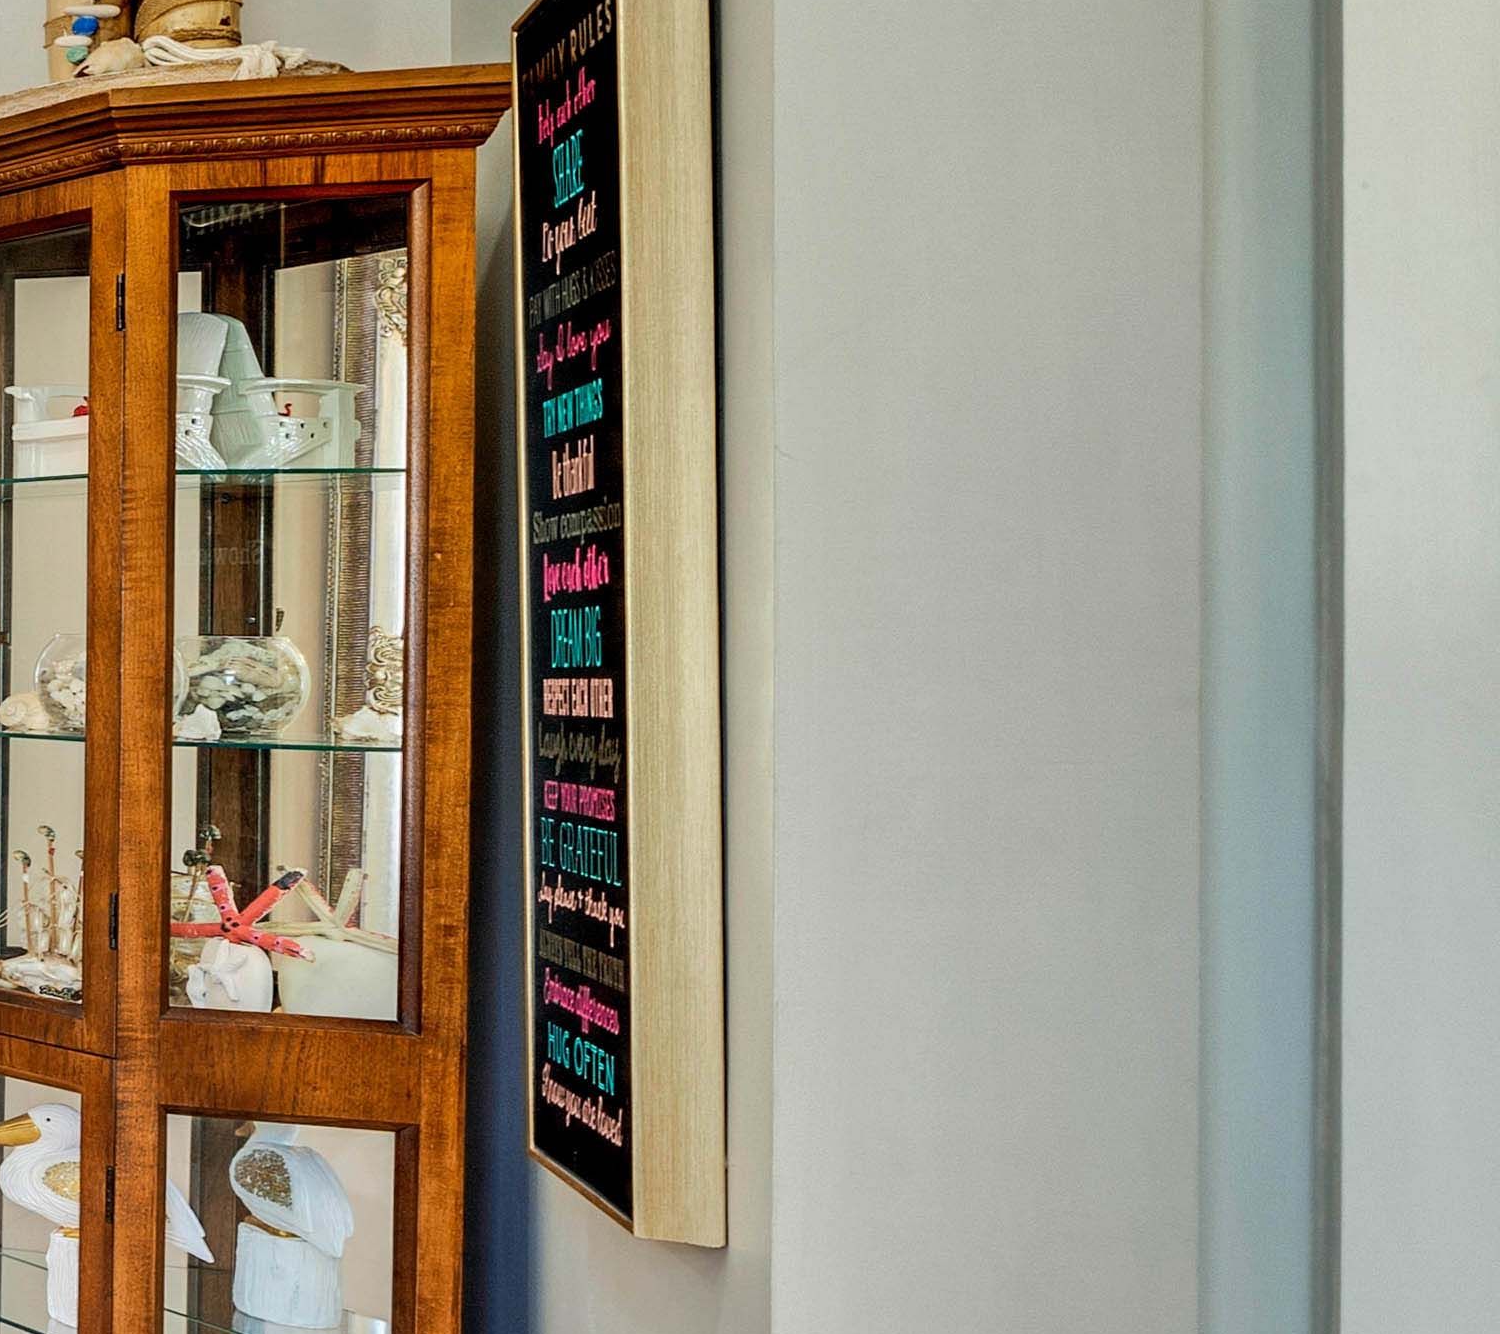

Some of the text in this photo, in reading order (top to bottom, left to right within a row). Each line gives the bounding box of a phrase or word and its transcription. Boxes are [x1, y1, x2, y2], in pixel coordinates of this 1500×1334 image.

[553, 128, 585, 209] SHARE
[562, 269, 581, 311] HUGS
[533, 496, 621, 546] Show compassion
[551, 605, 602, 668] DREAM BIG
[541, 816, 622, 887] BE GRATEFUL
[547, 1020, 616, 1097] HUG OFTEN
